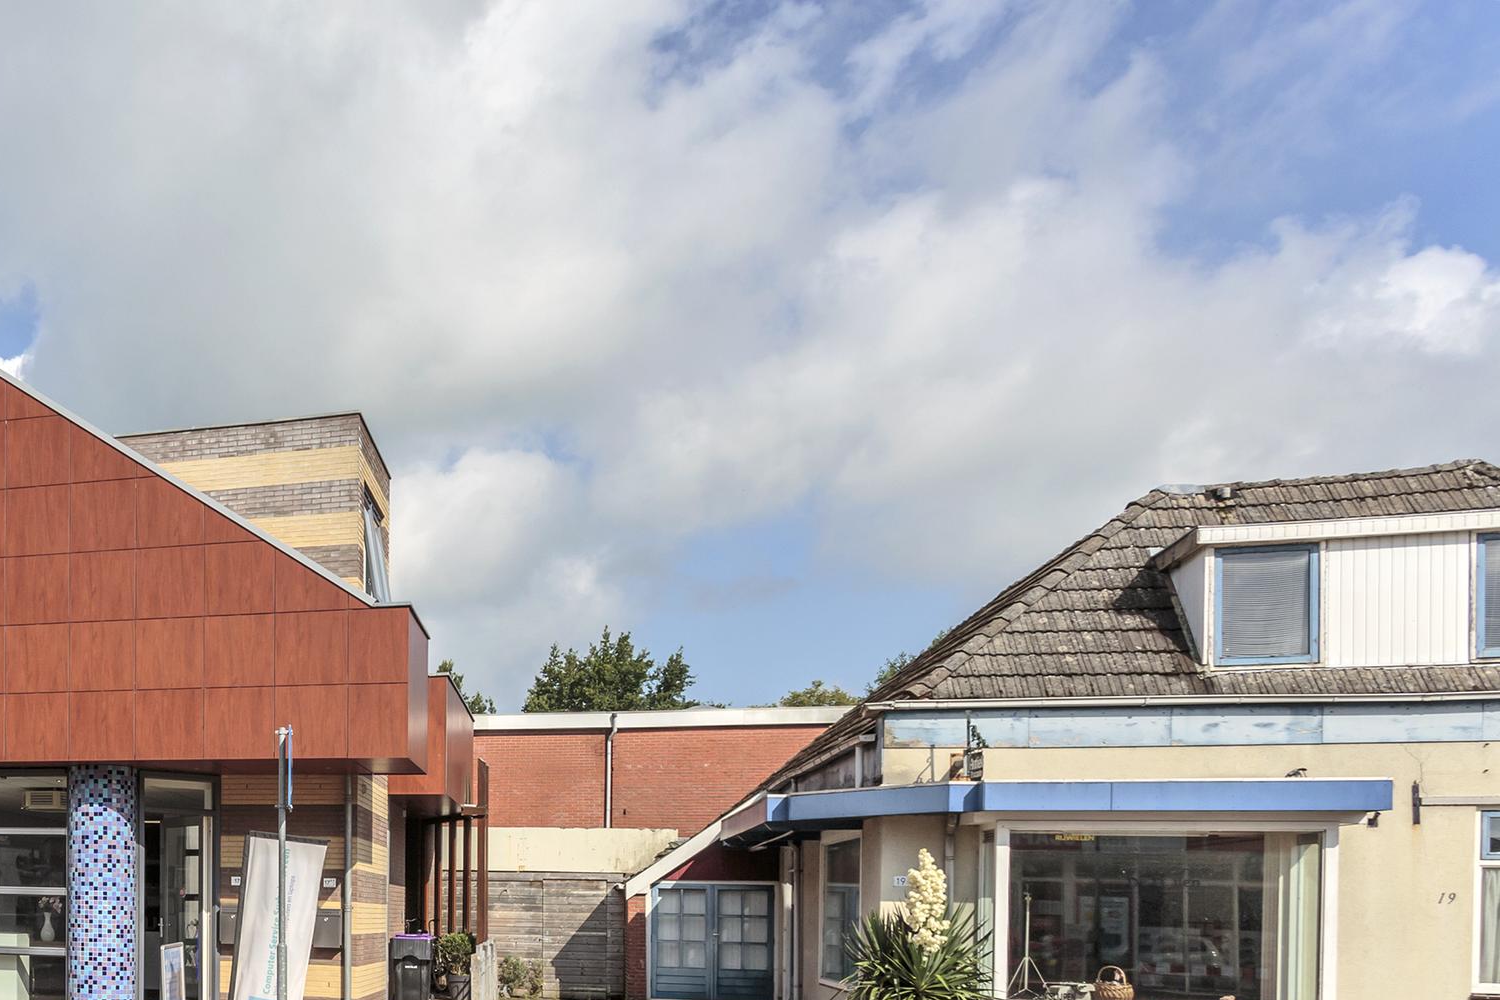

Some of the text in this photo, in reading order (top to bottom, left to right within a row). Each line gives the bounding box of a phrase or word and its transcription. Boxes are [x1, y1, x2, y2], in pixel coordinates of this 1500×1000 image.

[896, 877, 907, 886] 19
[1437, 892, 1457, 905] 19
[262, 951, 275, 995] Computer
